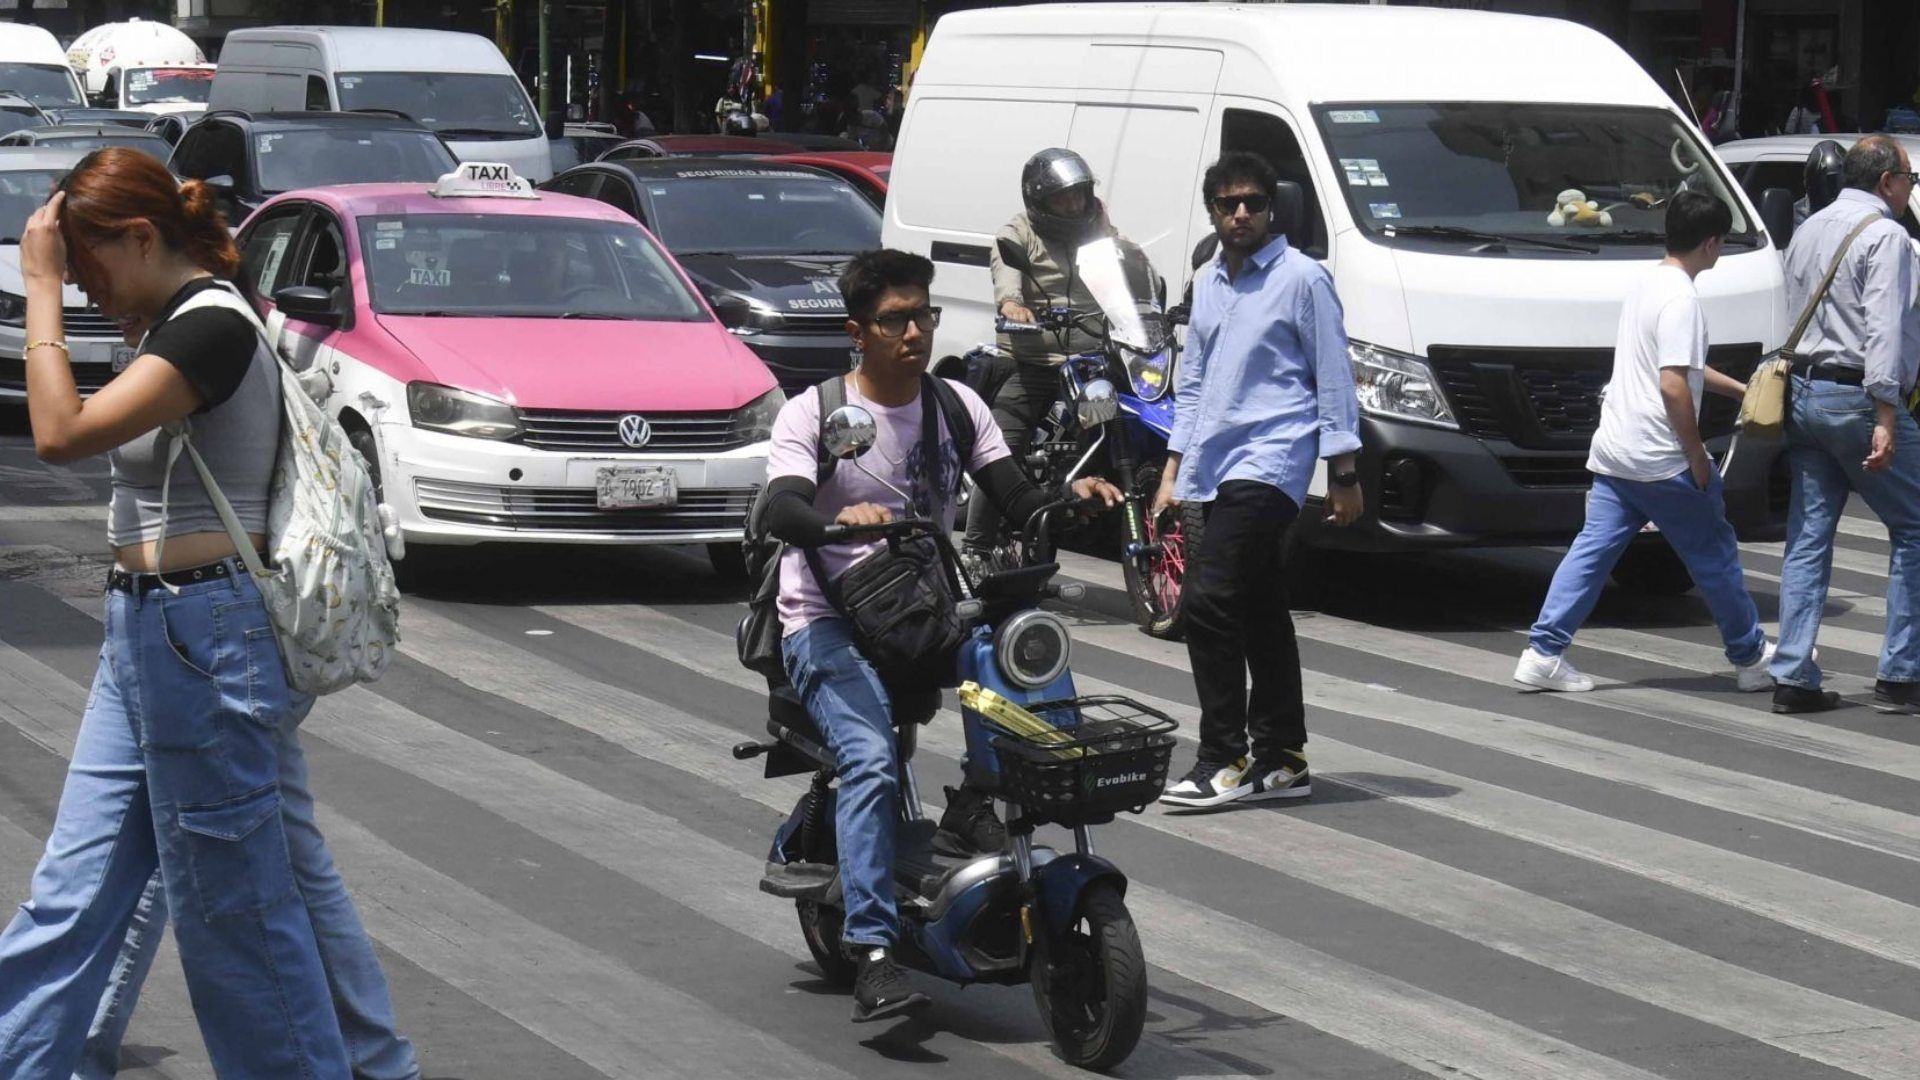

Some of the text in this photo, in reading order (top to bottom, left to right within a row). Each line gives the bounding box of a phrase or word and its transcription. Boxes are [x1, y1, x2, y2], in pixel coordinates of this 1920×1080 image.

[467, 165, 508, 180] TAXI
[412, 269, 448, 286] TAXI
[1097, 771, 1147, 787] Evobike
